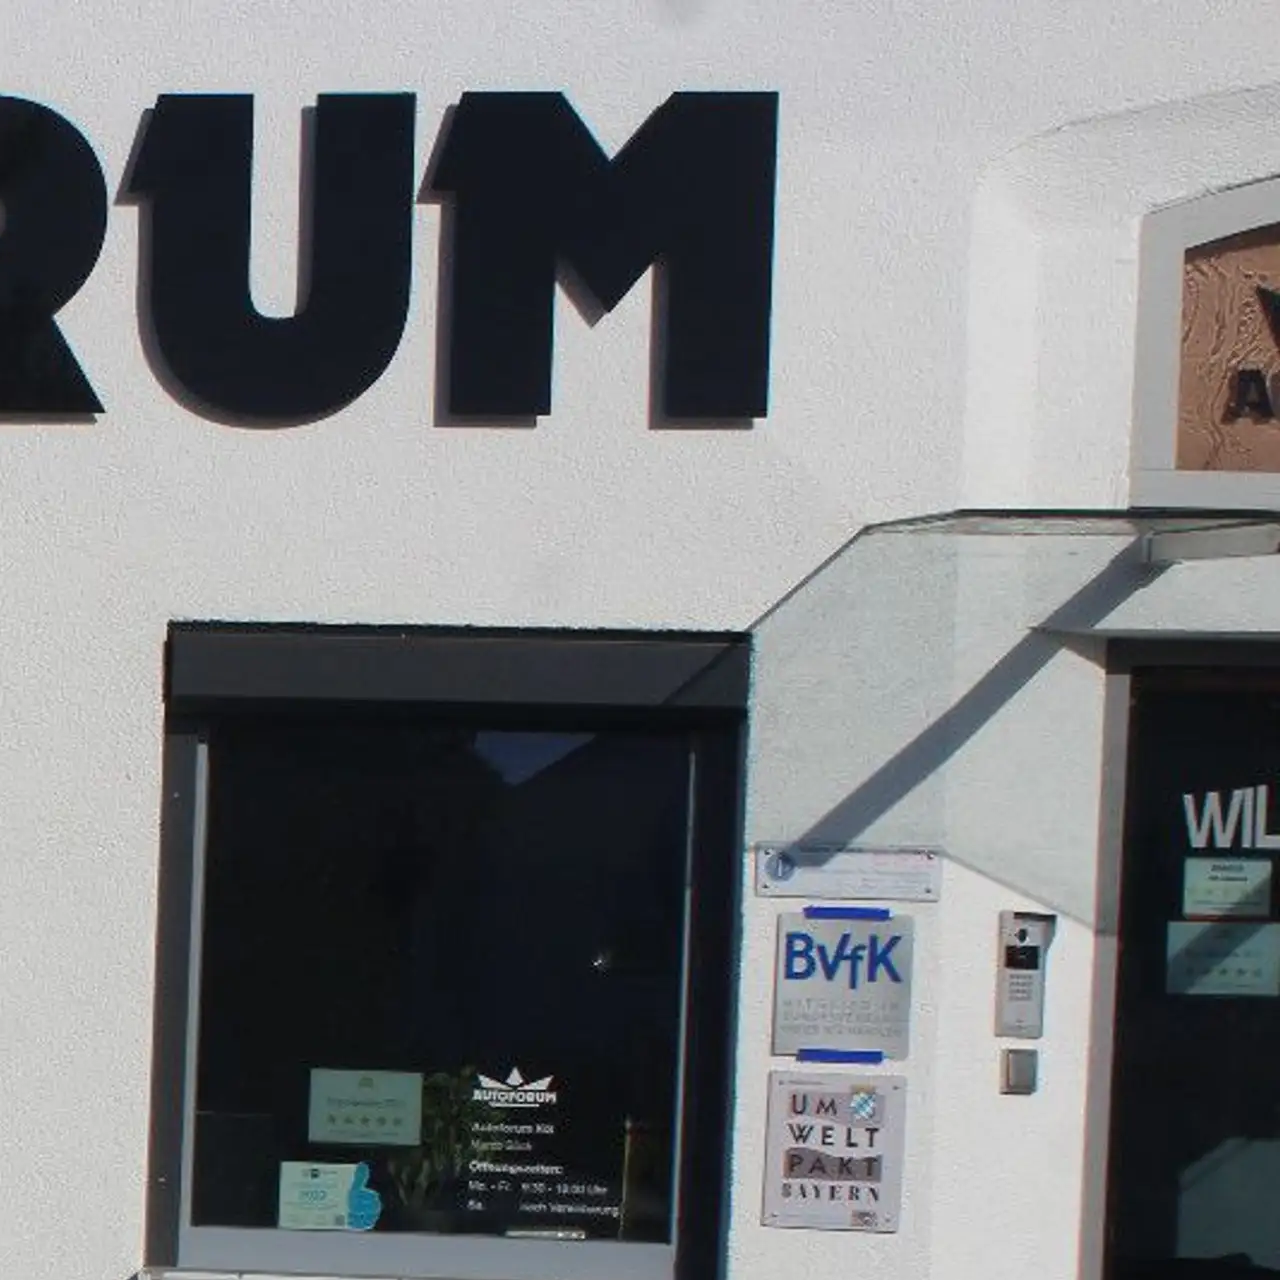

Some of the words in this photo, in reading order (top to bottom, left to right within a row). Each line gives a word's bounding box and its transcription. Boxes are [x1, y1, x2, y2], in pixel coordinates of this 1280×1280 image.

[472, 1089, 557, 1104] AUTOFORUM
[791, 1094, 838, 1116] UM
[788, 1124, 880, 1148] WELT
[789, 1154, 879, 1177] PAKT
[781, 1183, 880, 1202] BAYERN
